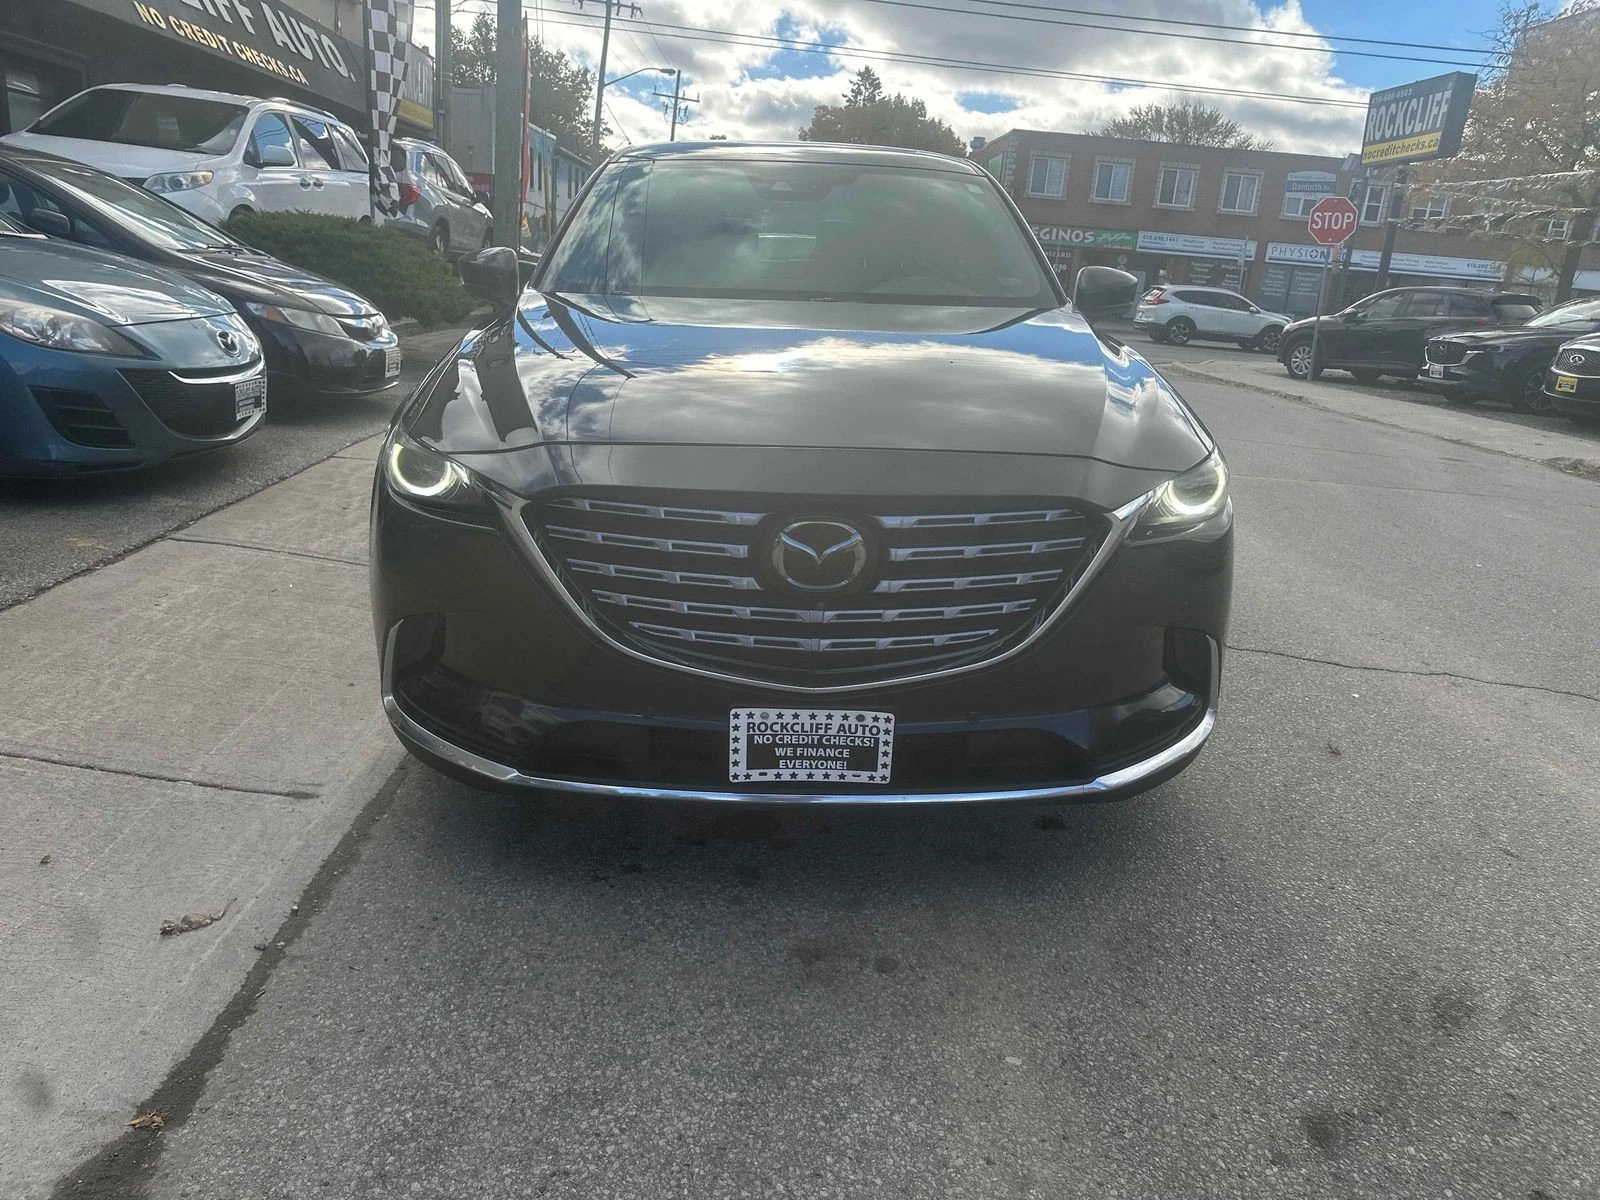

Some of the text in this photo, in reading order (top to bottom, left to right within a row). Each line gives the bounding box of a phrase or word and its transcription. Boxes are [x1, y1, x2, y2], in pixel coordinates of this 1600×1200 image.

[133, 1, 310, 86] NO CREDIT CHECKS.CA
[1365, 90, 1452, 142] ROCKCLIFF
[1363, 138, 1439, 160] nocreditchecks.ca
[1292, 182, 1322, 192] Danforth
[1312, 212, 1354, 230] STOP
[746, 722, 881, 737] ROCKCLIFF AUTO
[754, 735, 875, 747] NO CREDIT CHECKS!
[775, 747, 850, 758] WE FINANCE
[779, 760, 848, 770] EVERYONE!
